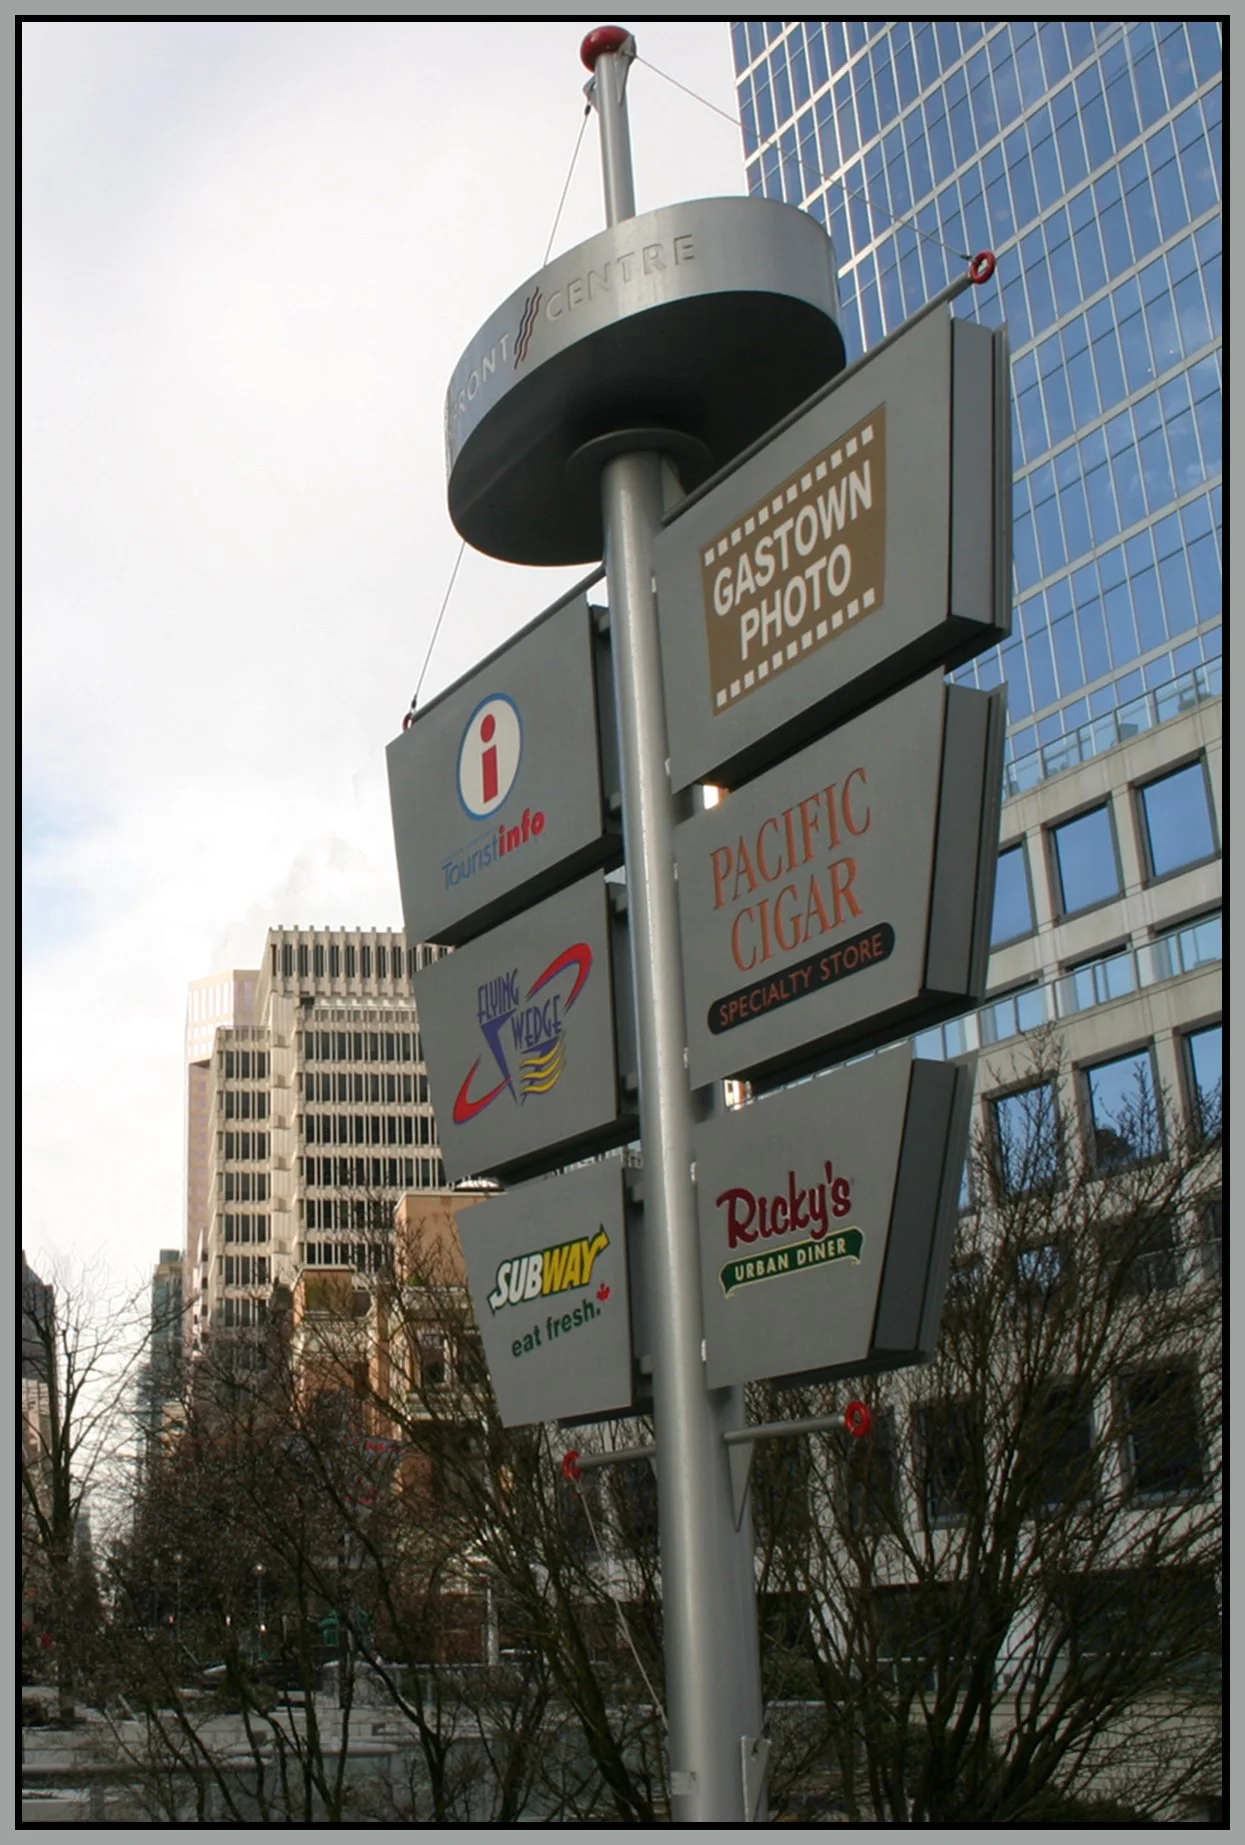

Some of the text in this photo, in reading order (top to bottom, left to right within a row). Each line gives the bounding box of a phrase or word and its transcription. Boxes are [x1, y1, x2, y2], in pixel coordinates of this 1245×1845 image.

[545, 233, 697, 321] CENTRE
[713, 459, 873, 616] GASTOWN
[740, 543, 852, 661] PHOTO
[709, 766, 872, 911] PACIFIC
[731, 856, 864, 972] CIGAR
[477, 967, 519, 1024] FLYING
[511, 994, 562, 1051] WEDGE
[719, 931, 883, 1026] SPECIALTY STORE
[715, 1159, 851, 1249] Ricky's
[487, 1223, 611, 1317] SUBWAY
[734, 1237, 847, 1281] URBAN DINER
[511, 1325, 542, 1358] eat
